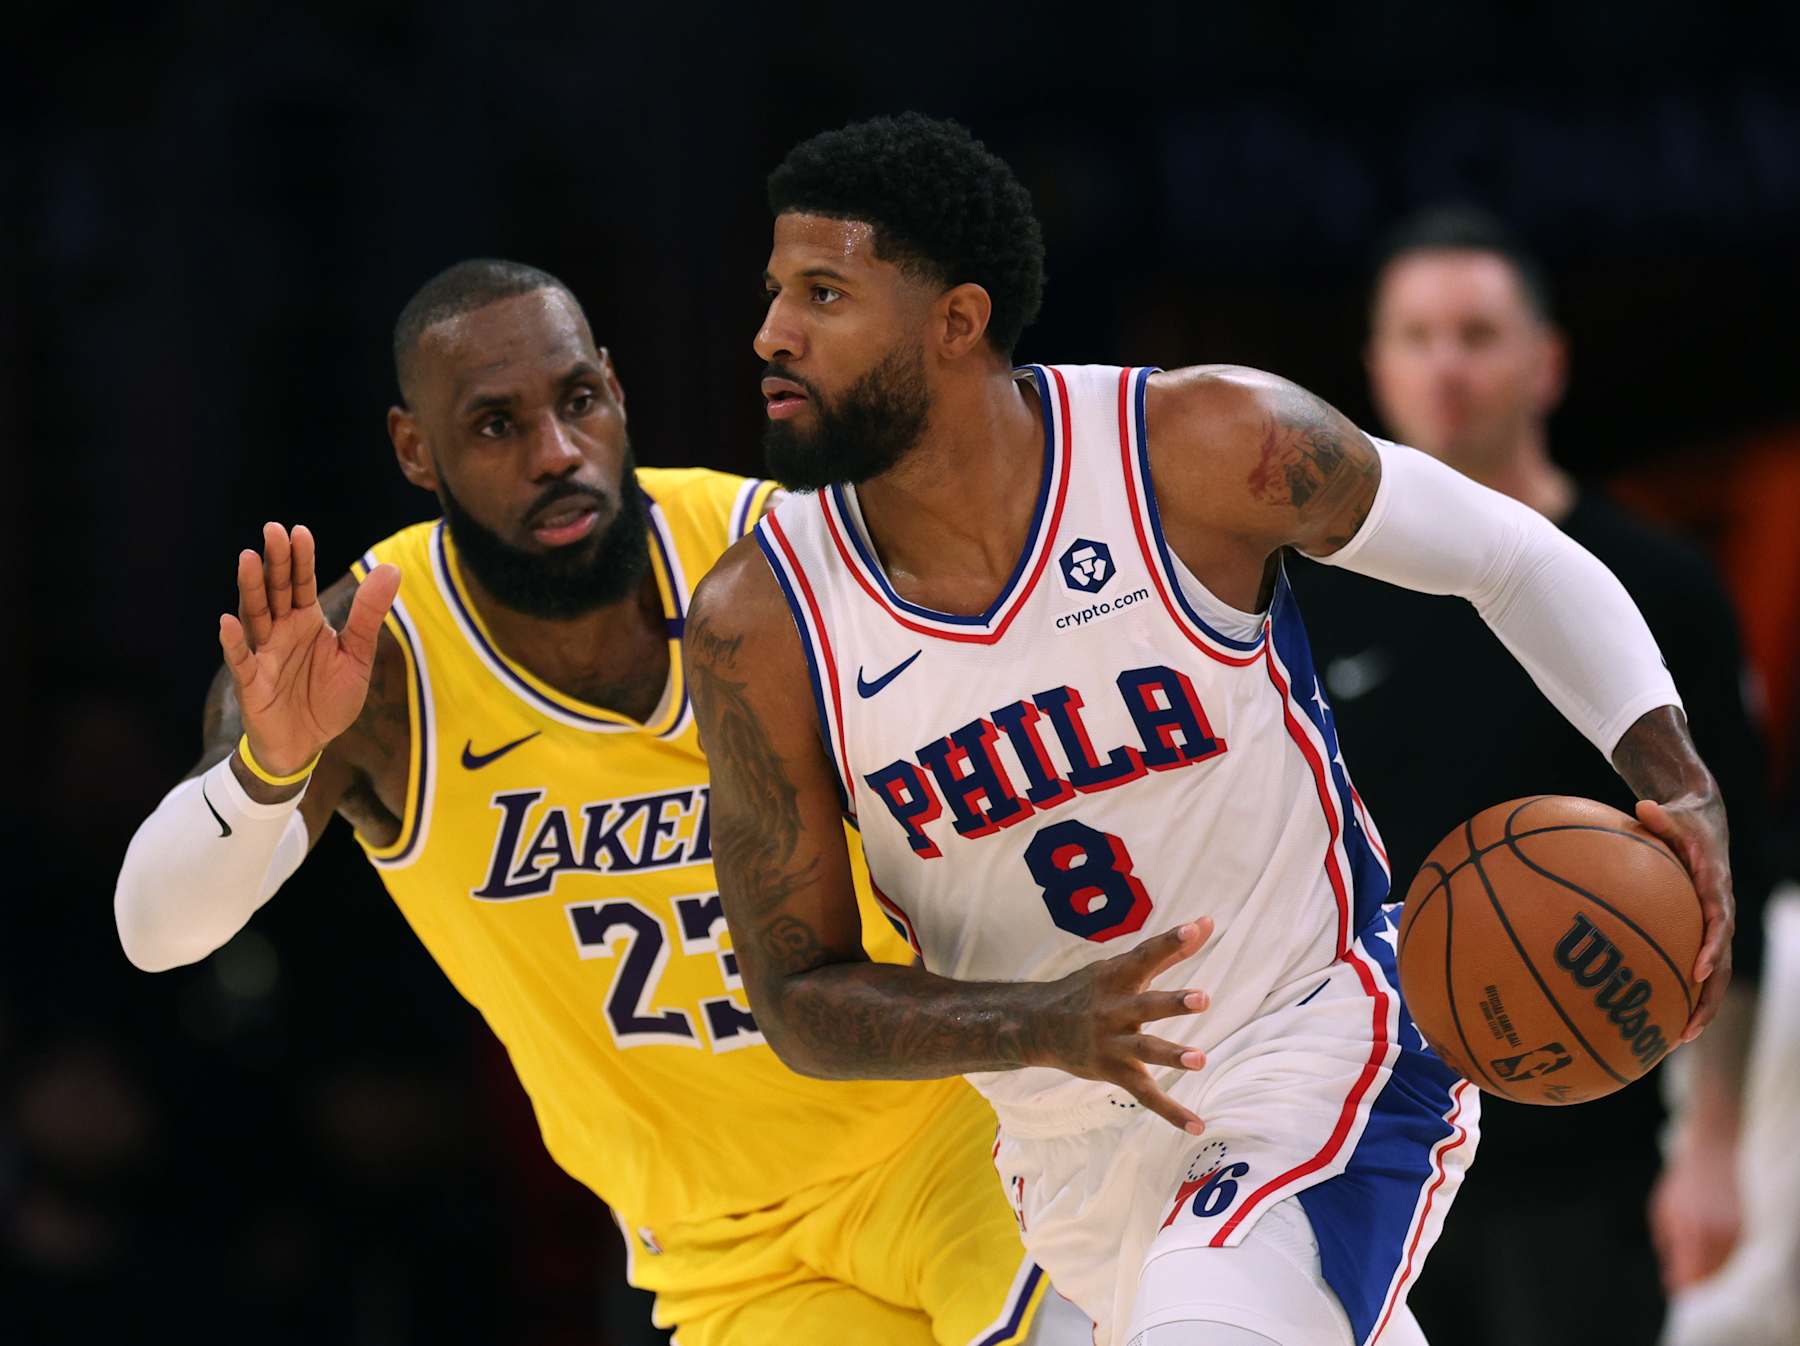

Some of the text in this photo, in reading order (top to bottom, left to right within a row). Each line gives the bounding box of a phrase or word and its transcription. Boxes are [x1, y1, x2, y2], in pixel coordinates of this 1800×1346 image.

[1056, 588, 1149, 629] crypto.com
[864, 665, 1228, 860] PHILA
[471, 785, 712, 900] LAKE
[1023, 819, 1153, 943] 8
